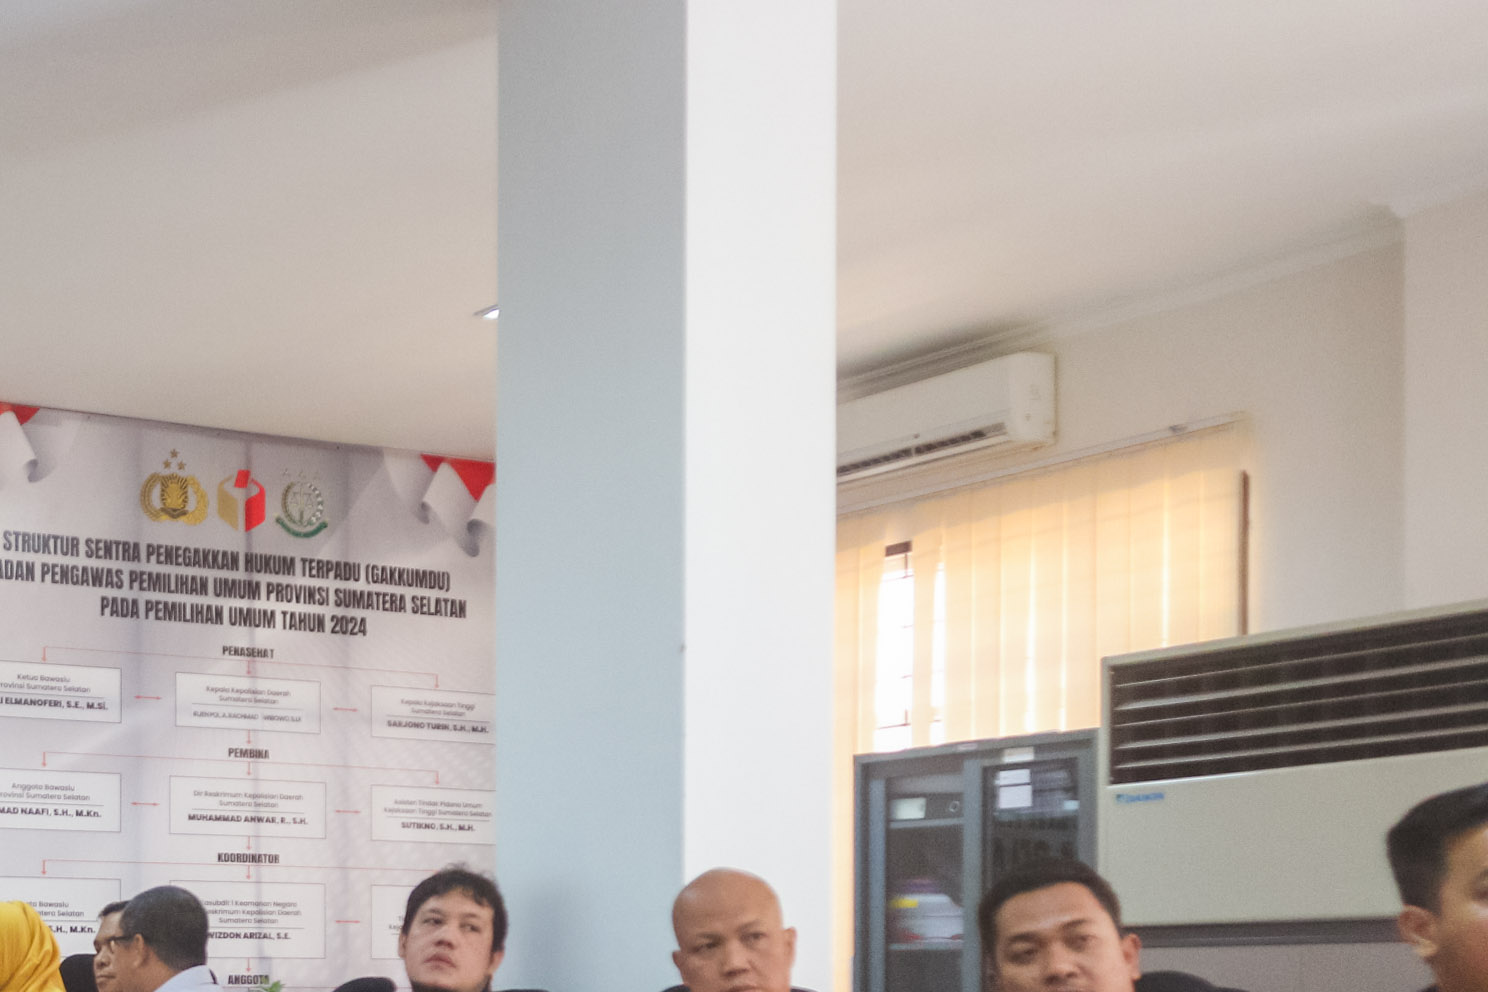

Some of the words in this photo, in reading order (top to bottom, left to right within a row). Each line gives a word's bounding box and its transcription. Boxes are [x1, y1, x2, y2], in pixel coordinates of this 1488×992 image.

[2, 530, 80, 557] STRUKTUR
[84, 538, 141, 563] SENTRA
[146, 543, 240, 572] PENEGAKKAN
[244, 552, 296, 577] HUKUM
[300, 557, 361, 583] TERPADU
[365, 563, 451, 592] (GAKKUMDU)
[40, 562, 124, 590] PENGAWAS
[129, 570, 209, 596] PEMILIHAN
[213, 577, 261, 601] UMUM
[266, 583, 330, 606] PROVINSI
[334, 589, 407, 613] SUMATERA
[411, 596, 468, 619] SELATAN
[100, 596, 140, 620] PADA
[145, 599, 224, 626] PEMILIHAN
[228, 606, 276, 629] UMUM
[281, 610, 326, 633] TAHUN
[330, 614, 368, 637] 2024
[222, 645, 275, 659] PENASEHAT
[26, 683, 62, 692] Sumatera
[63, 685, 91, 693] Selatan
[228, 747, 270, 759] PEMBINA
[44, 784, 75, 792] Bawaslu
[26, 791, 62, 800] Sumatera
[63, 793, 90, 801] Selatan
[188, 813, 242, 823] MUHAMMAD
[217, 852, 280, 864] KOORDINATOR
[57, 910, 84, 918] Selatan
[69, 925, 95, 934] M.Kn.
